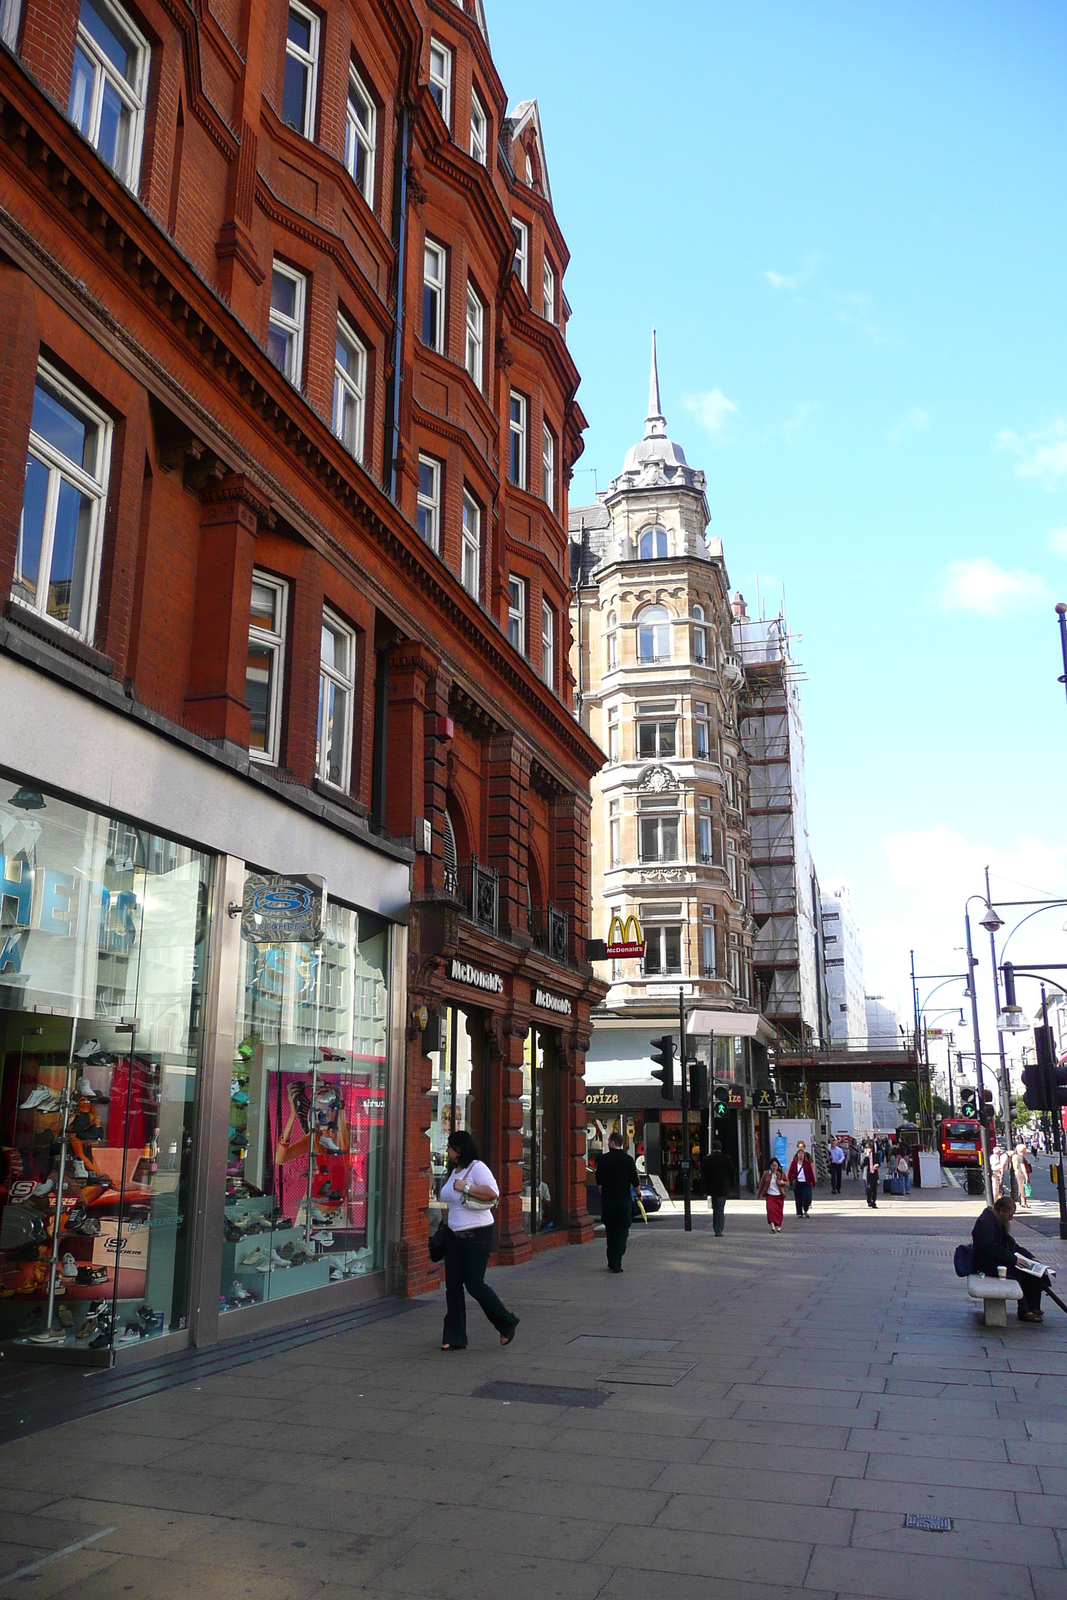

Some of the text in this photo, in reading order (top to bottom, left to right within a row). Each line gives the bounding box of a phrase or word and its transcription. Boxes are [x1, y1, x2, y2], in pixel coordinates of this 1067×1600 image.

[249, 921, 309, 932] SKECHERS
[606, 946, 643, 954] McDonald's
[451, 959, 503, 993] McDonald's
[535, 989, 571, 1014] McDonald's
[582, 1087, 619, 1104] orize
[728, 1089, 742, 1102] ize
